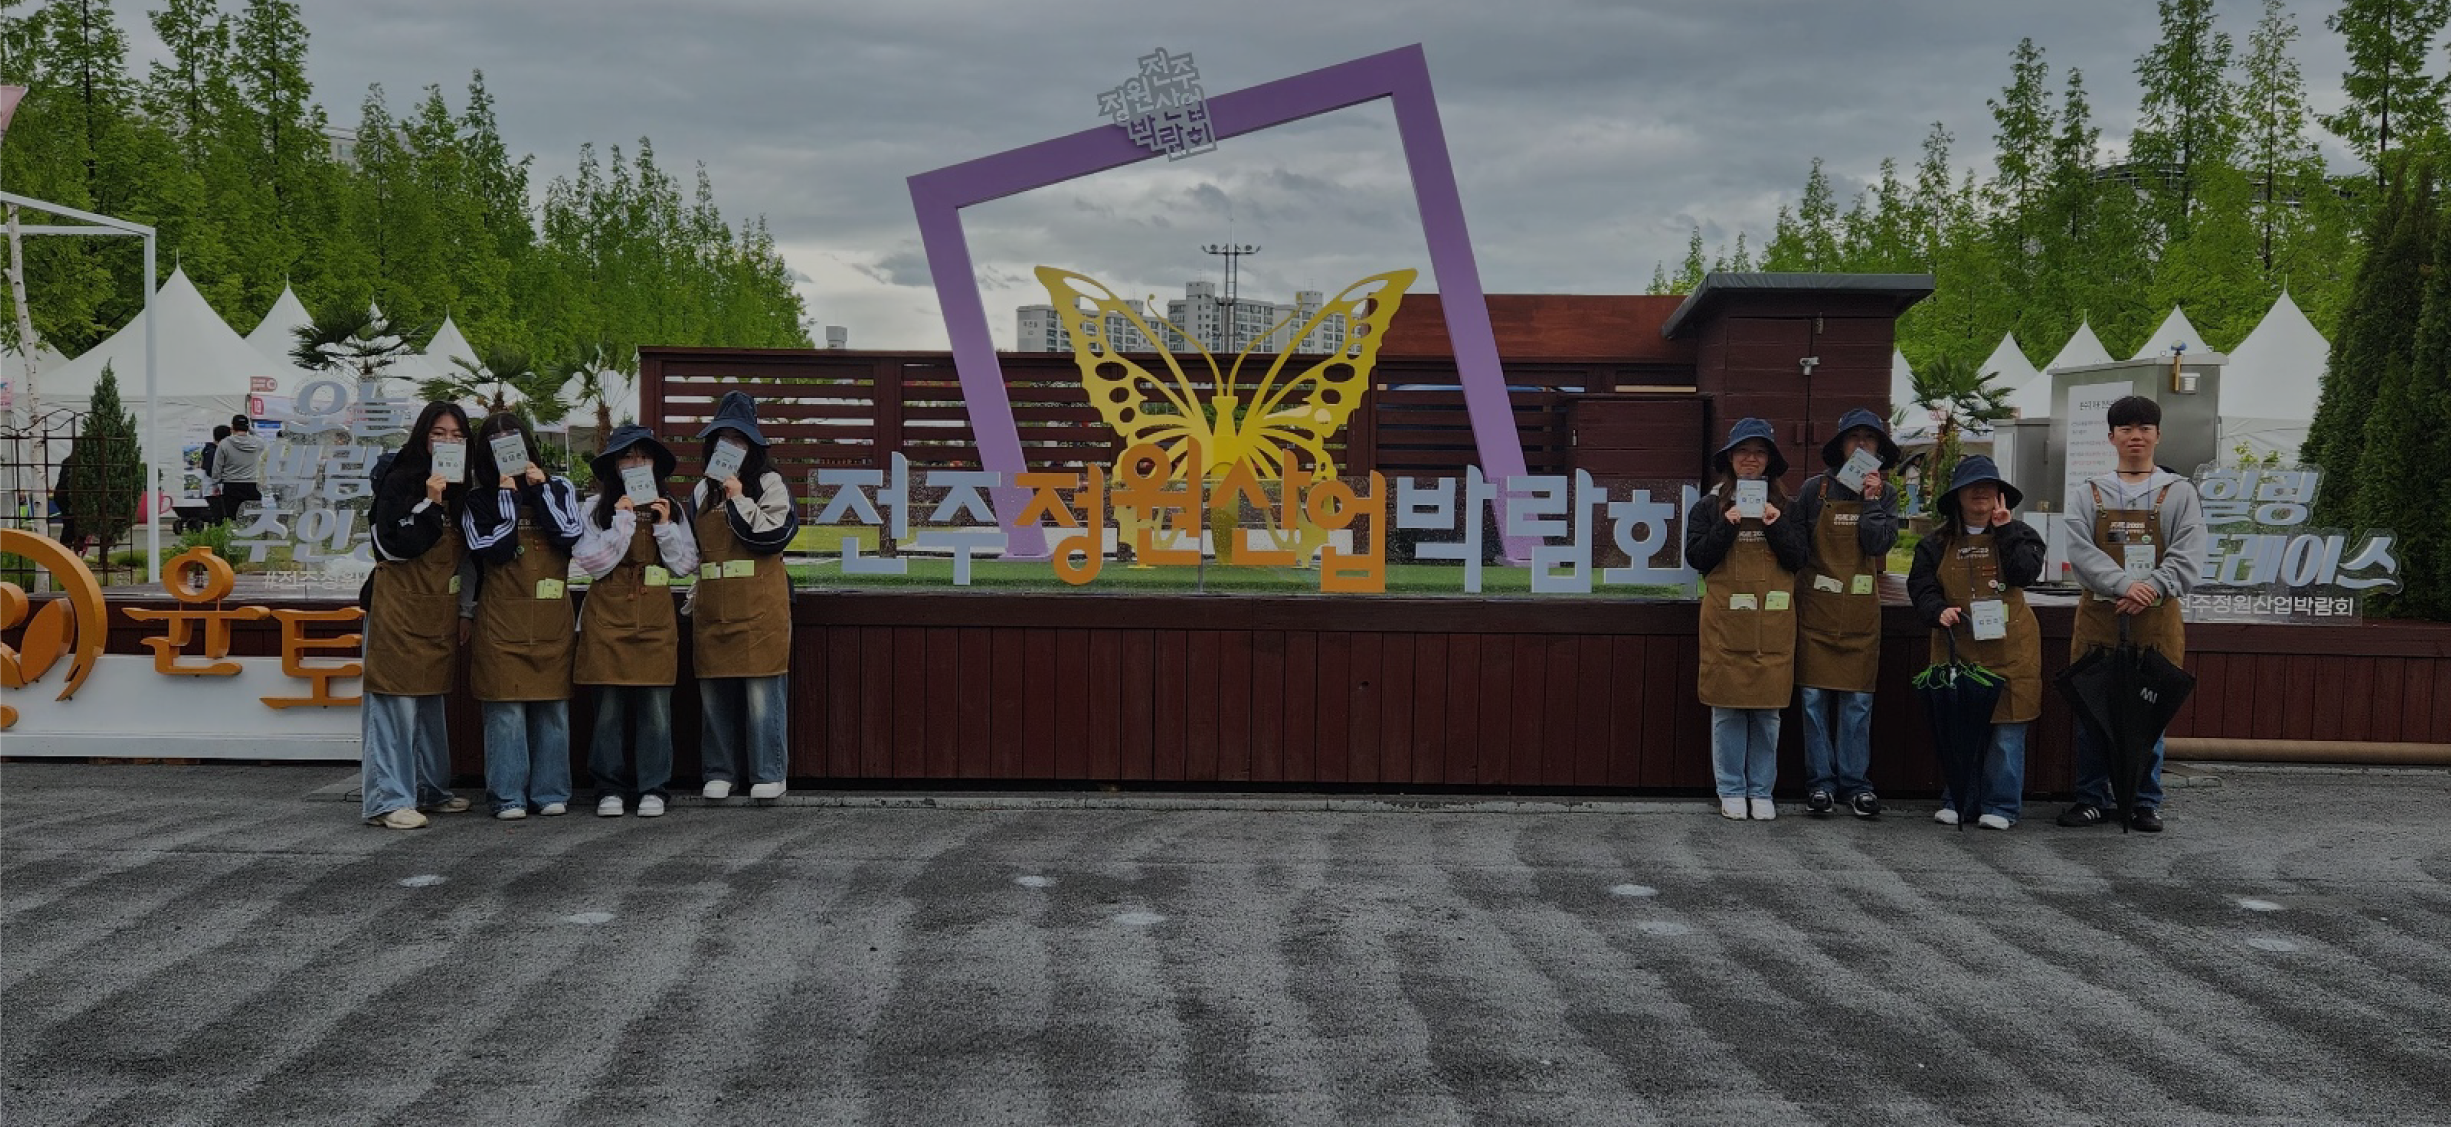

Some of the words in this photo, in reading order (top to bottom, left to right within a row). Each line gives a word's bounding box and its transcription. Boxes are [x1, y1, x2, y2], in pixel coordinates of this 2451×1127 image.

[1140, 50, 1197, 90] 전주
[1129, 112, 1215, 158] 박람회
[287, 380, 410, 436] 오늘
[2200, 467, 2319, 525] 힐링
